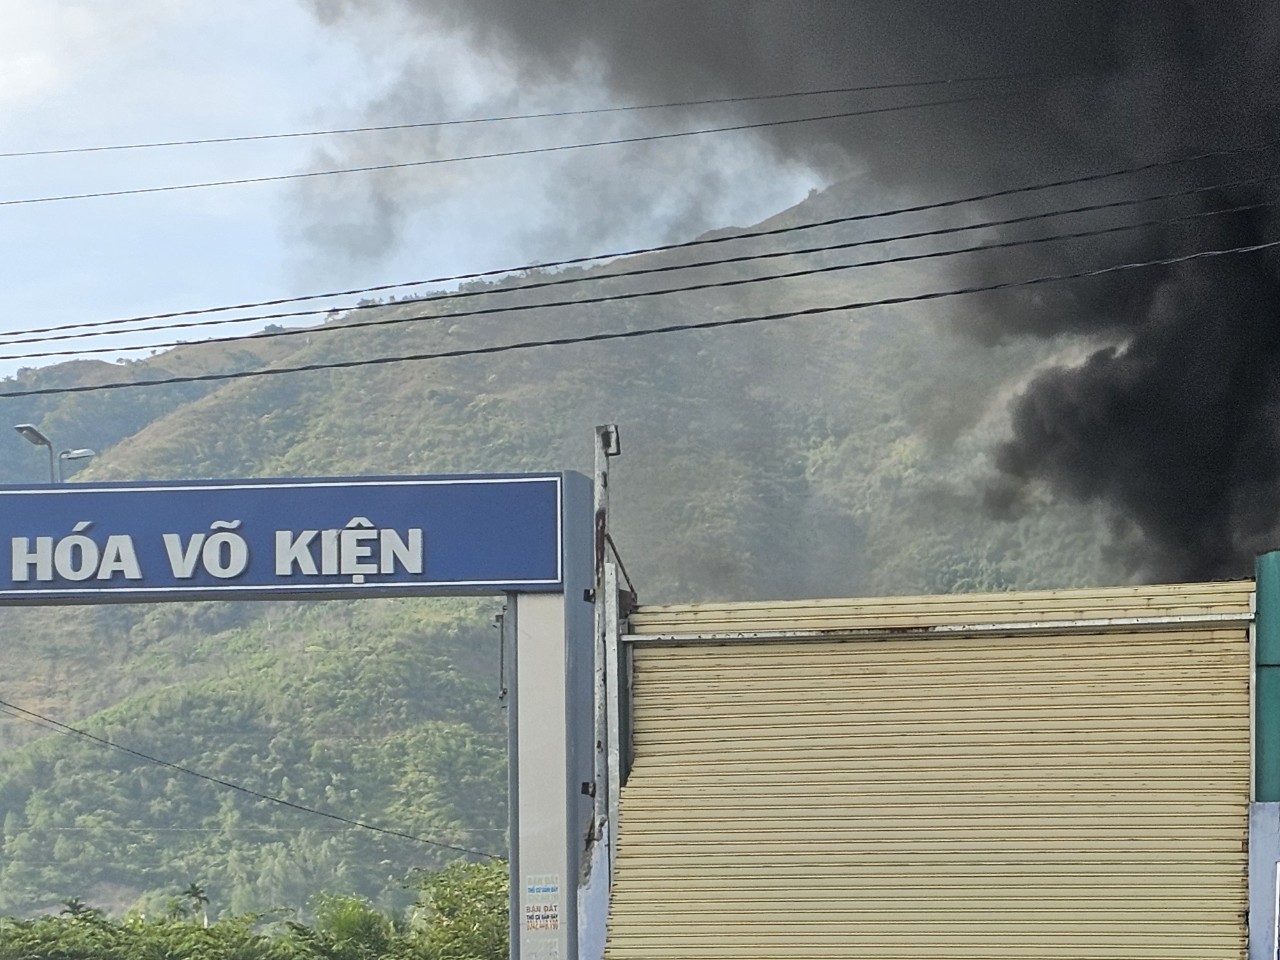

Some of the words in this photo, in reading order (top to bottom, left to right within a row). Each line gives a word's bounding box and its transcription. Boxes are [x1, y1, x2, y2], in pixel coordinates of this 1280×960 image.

[11, 520, 143, 582] HÓA
[162, 519, 250, 579] VÕ
[275, 516, 423, 584] KIỆN
